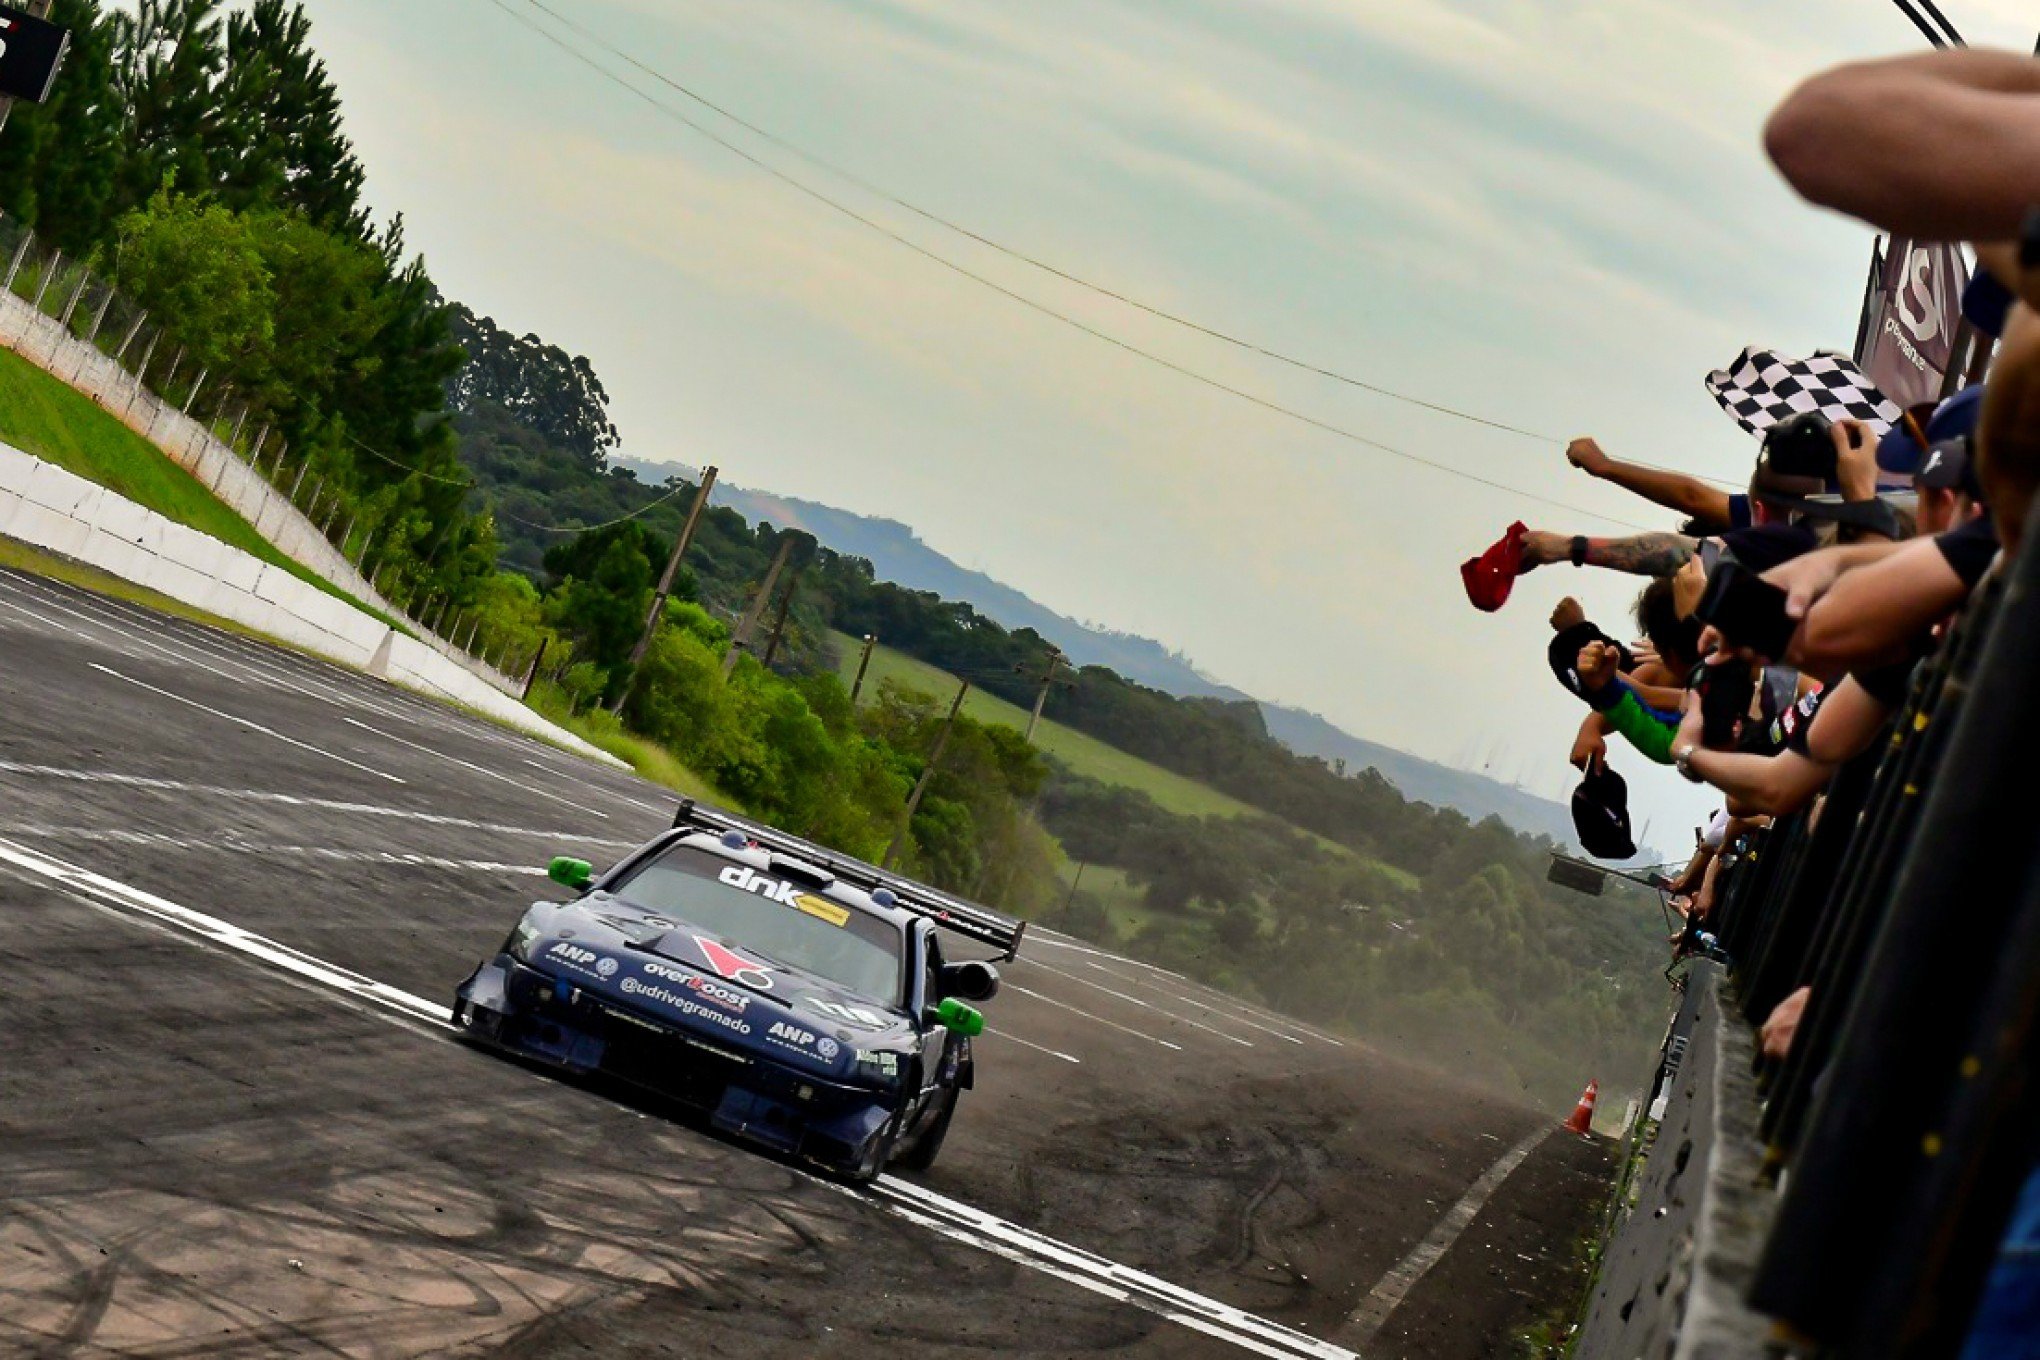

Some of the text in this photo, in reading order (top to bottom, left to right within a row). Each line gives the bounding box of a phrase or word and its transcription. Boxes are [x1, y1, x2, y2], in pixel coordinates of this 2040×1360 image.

[718, 865, 804, 908] dnk
[549, 943, 597, 963] ANP
[620, 976, 751, 1034] @udrivegramado
[767, 1021, 816, 1045] ANP
